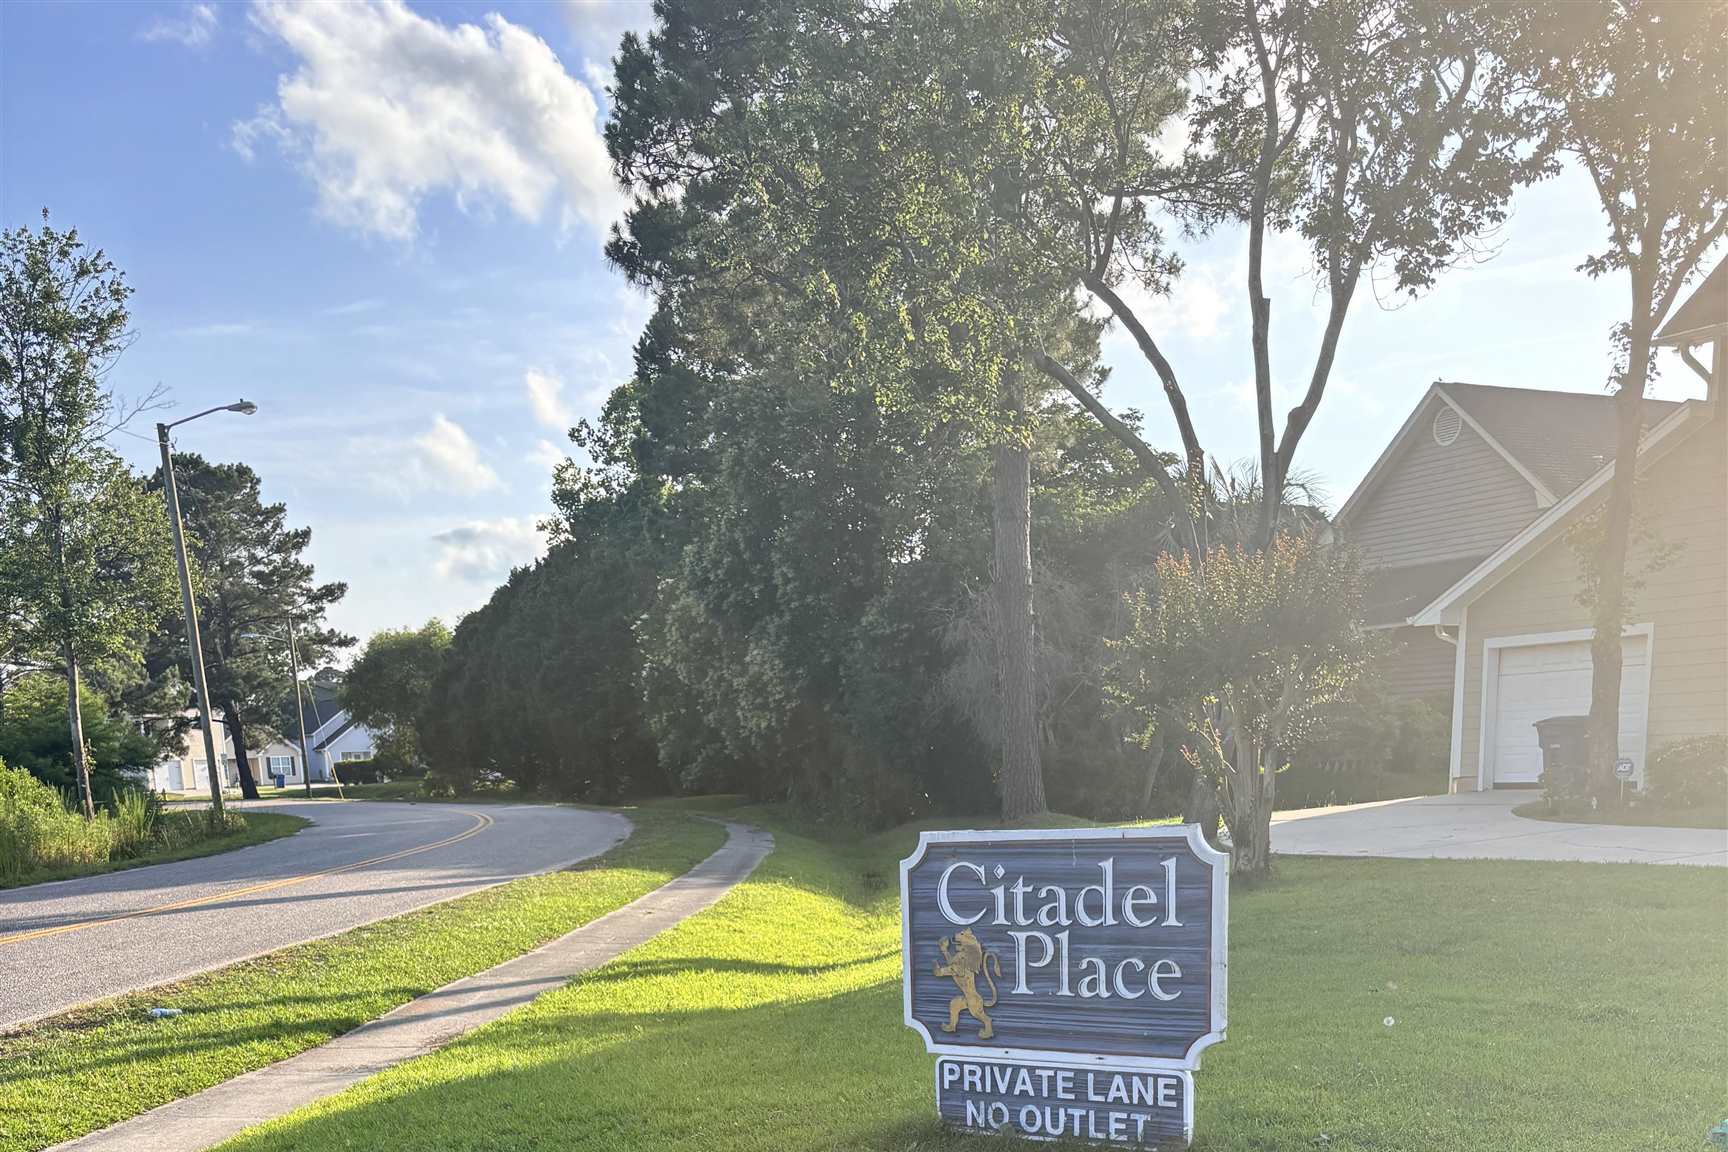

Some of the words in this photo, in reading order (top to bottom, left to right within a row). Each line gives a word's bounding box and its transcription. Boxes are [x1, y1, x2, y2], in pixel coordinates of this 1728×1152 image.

[936, 857, 1184, 927] Citadel
[1007, 930, 1183, 1001] Place
[943, 1063, 1077, 1099] PRIVATE
[1087, 1072, 1178, 1108] LANE
[966, 1100, 1010, 1130] NO
[1019, 1104, 1151, 1143] OUTLET
